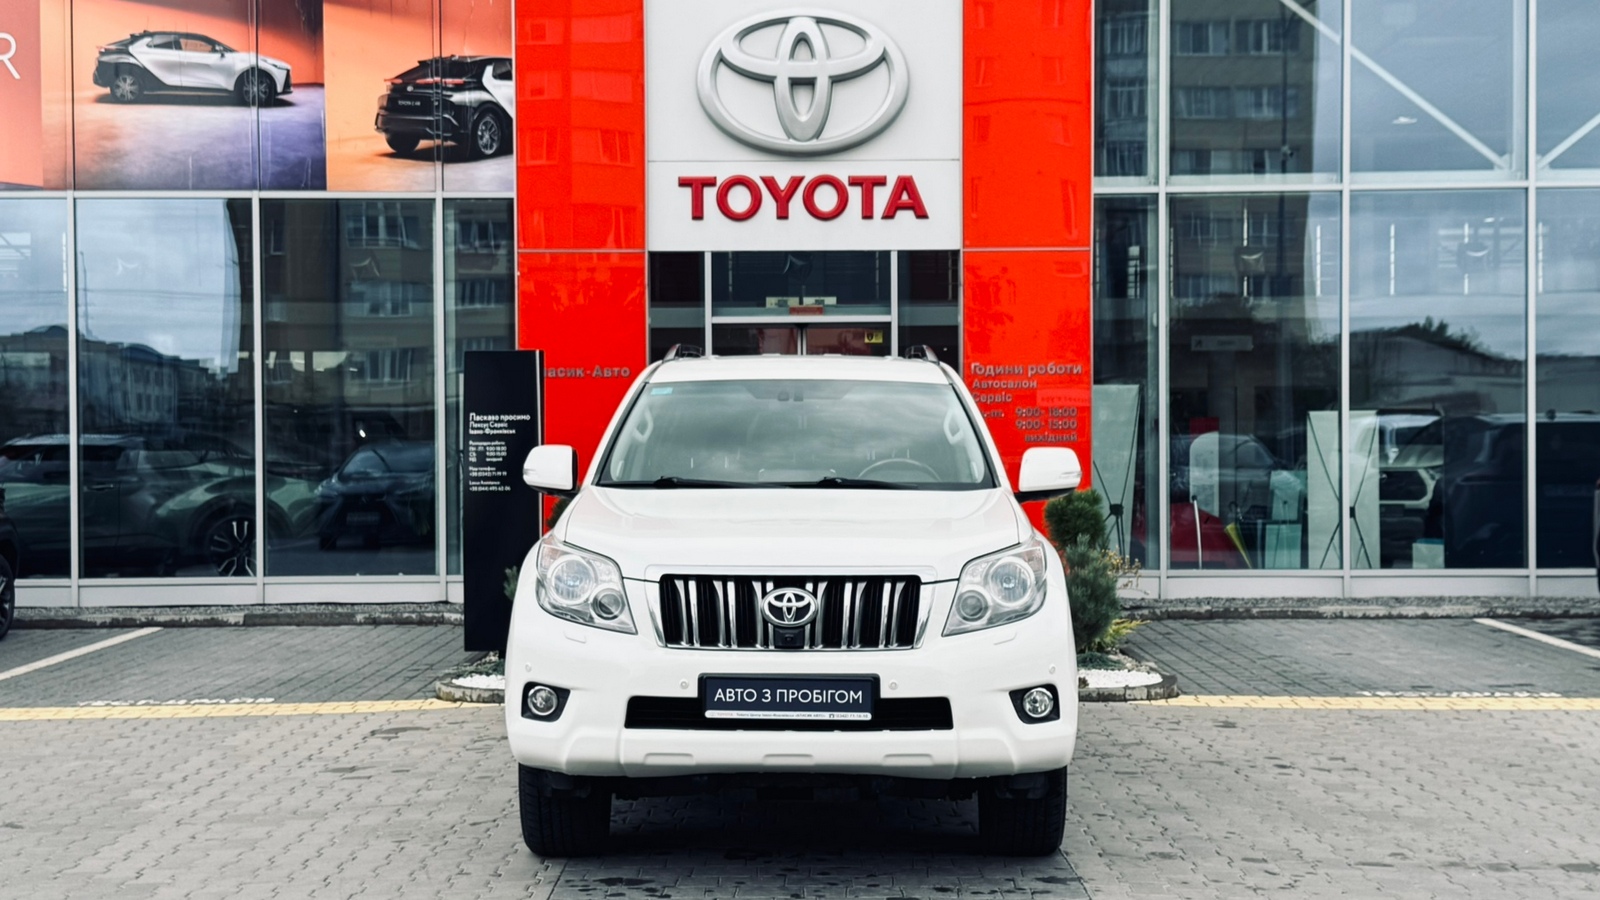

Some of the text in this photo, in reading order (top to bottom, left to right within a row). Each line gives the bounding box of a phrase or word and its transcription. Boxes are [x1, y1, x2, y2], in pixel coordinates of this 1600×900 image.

[678, 174, 929, 221] TOYOTA
[544, 365, 631, 378] асик-Авто
[971, 361, 1082, 377] Години роботи
[972, 380, 1037, 389] Автосалон
[714, 688, 863, 704] АВТО З ПРОБІГОМ
